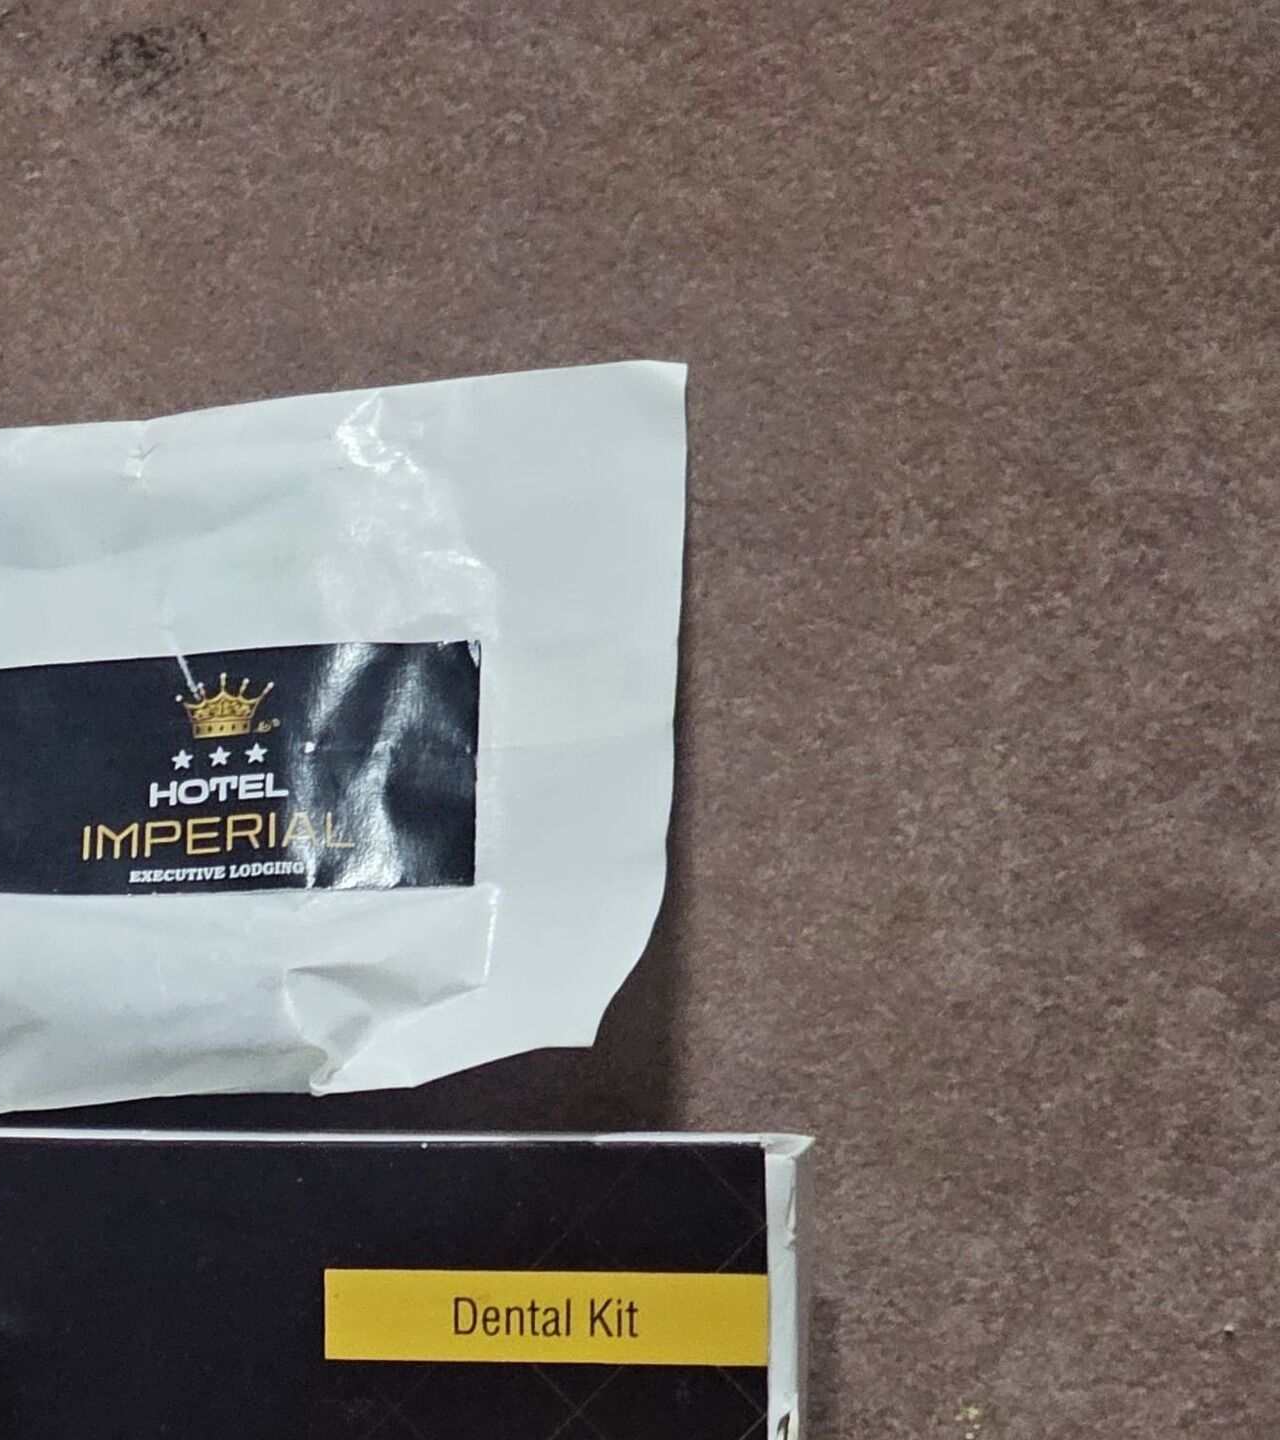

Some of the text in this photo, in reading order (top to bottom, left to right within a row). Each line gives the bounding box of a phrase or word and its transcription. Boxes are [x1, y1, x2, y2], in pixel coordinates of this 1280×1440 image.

[149, 773, 289, 808] HOTEL
[82, 811, 356, 861] IMPERIAL
[129, 860, 304, 883] EXECUTIVE LODGING
[453, 1297, 639, 1338] Dental Kit
